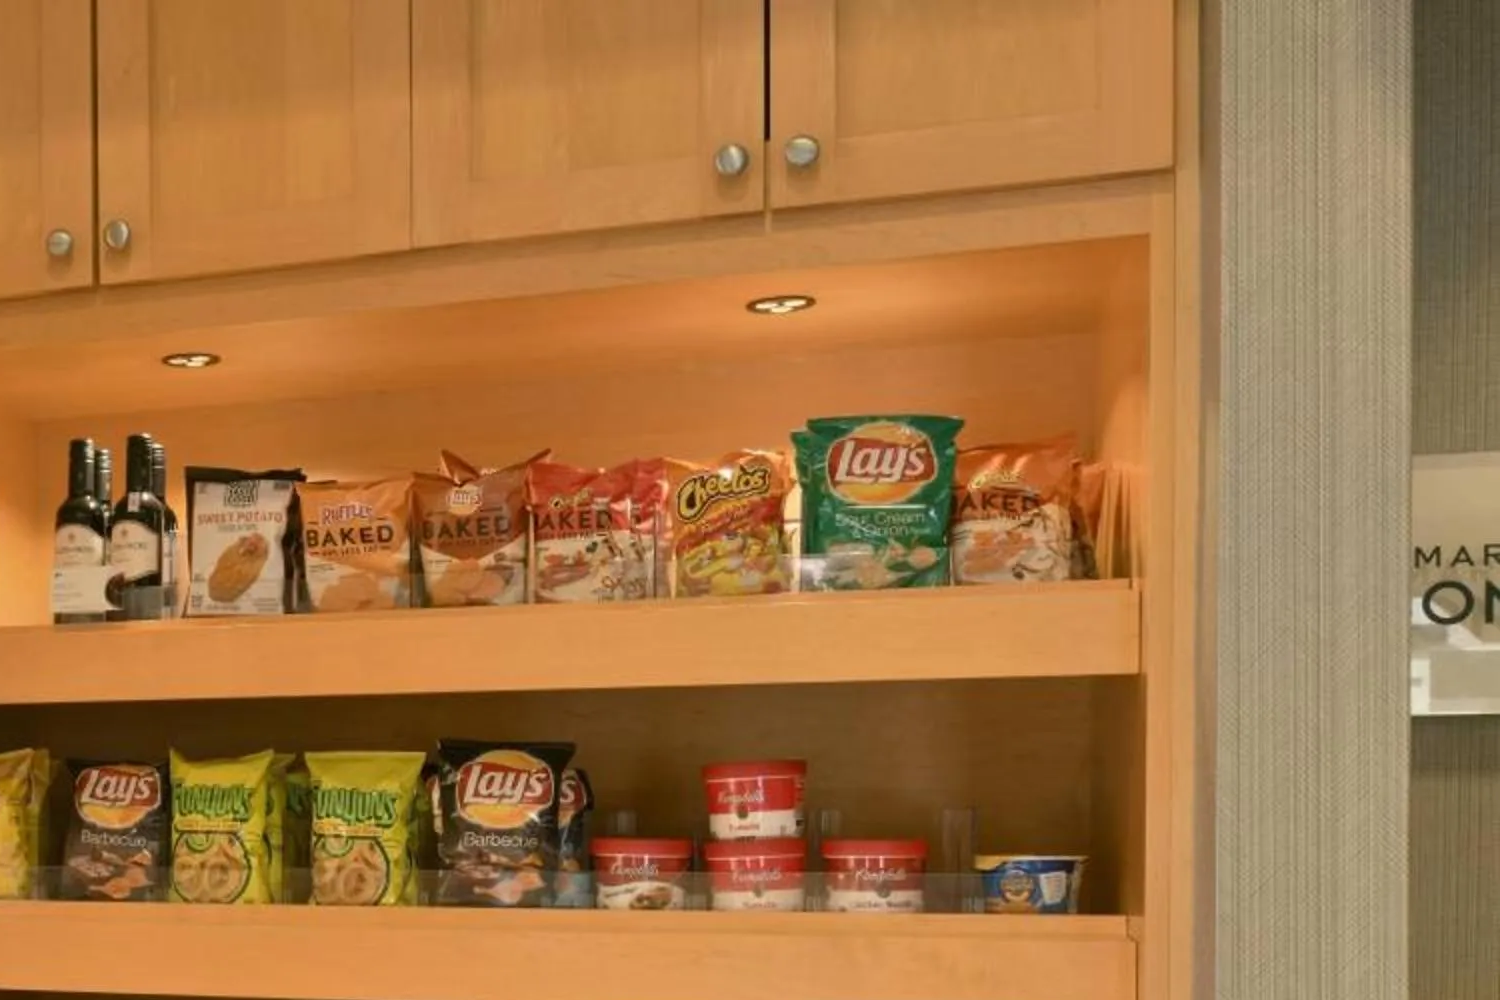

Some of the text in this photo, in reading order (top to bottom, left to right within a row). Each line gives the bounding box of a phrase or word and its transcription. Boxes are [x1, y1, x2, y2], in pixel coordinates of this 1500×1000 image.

[835, 440, 927, 483] Lay's
[959, 492, 1040, 514] AKED
[306, 525, 394, 548] BAKED
[464, 764, 548, 805] Lay's
